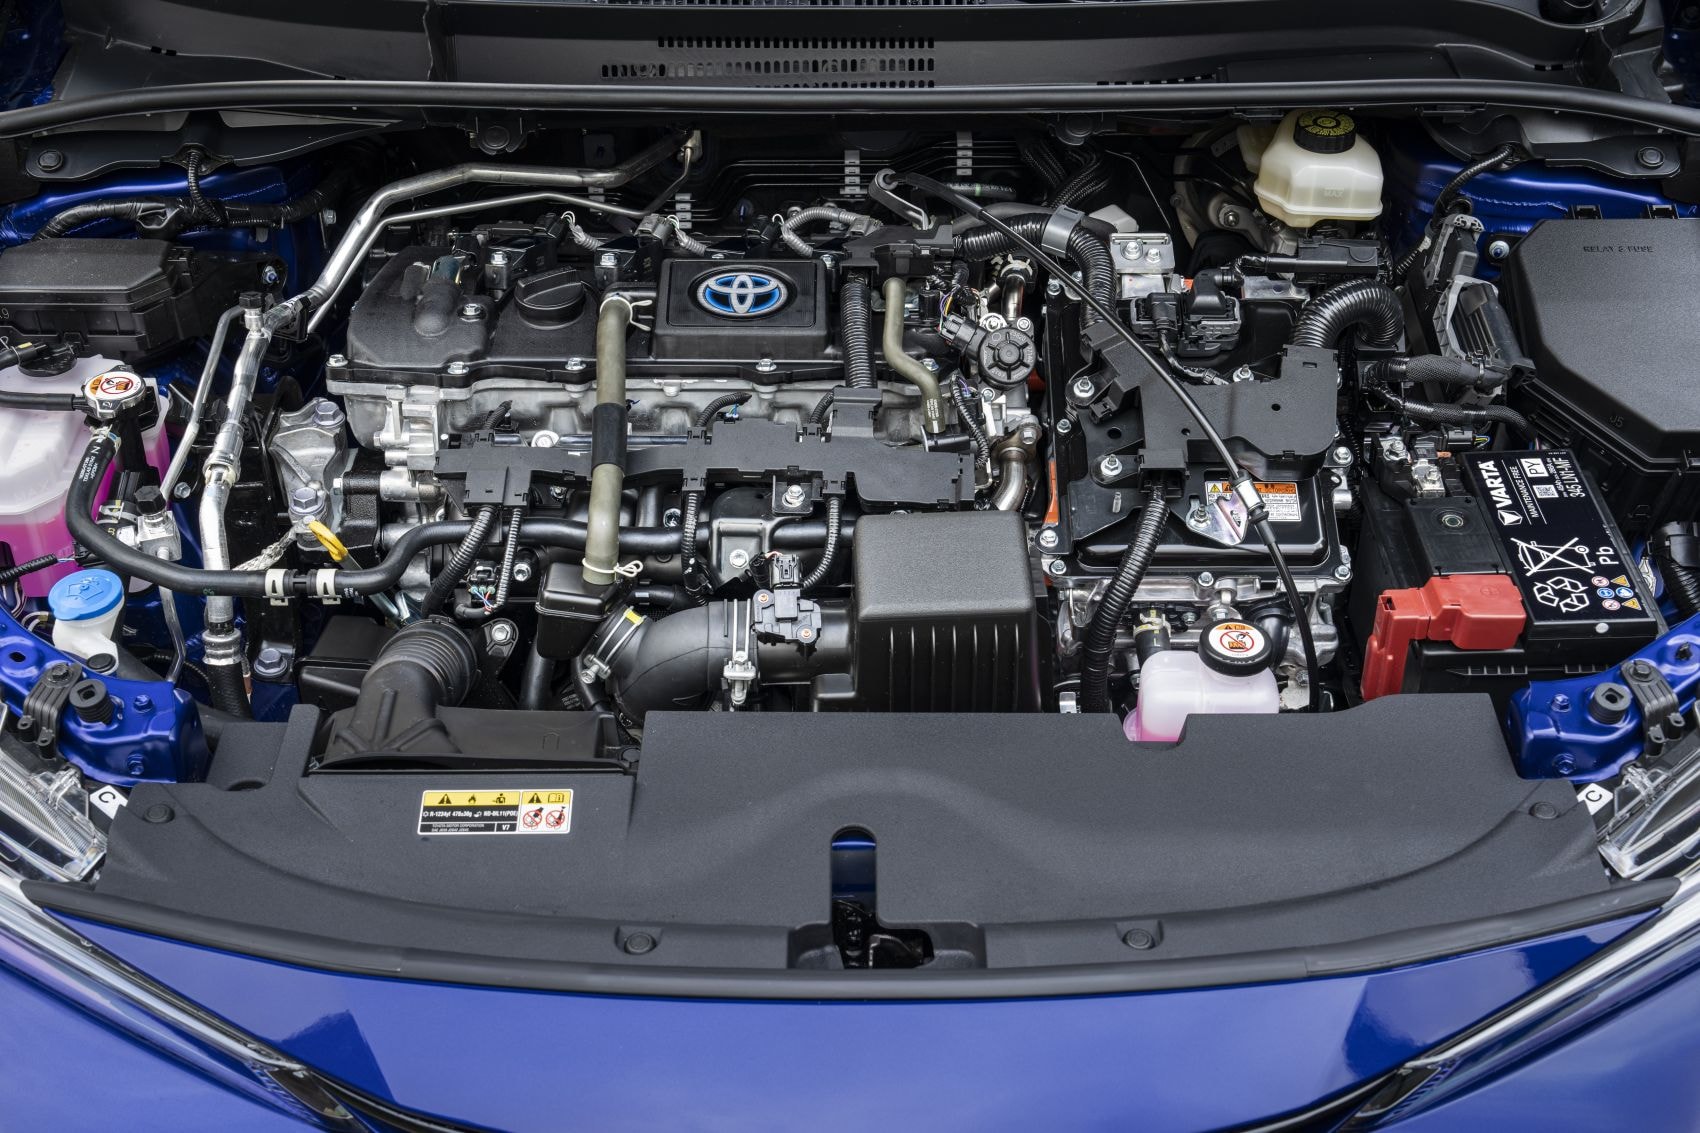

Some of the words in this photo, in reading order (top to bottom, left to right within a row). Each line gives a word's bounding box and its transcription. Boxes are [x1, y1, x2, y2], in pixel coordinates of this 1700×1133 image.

[1510, 465, 1522, 479] FREE
[1524, 459, 1545, 475] PY
[1479, 460, 1512, 508] VARTA
[1565, 484, 1586, 498] 345
[1516, 478, 1539, 518] MAINTENANCE
[1596, 546, 1619, 565] Pb
[99, 791, 116, 803] C
[1585, 790, 1603, 802] C
